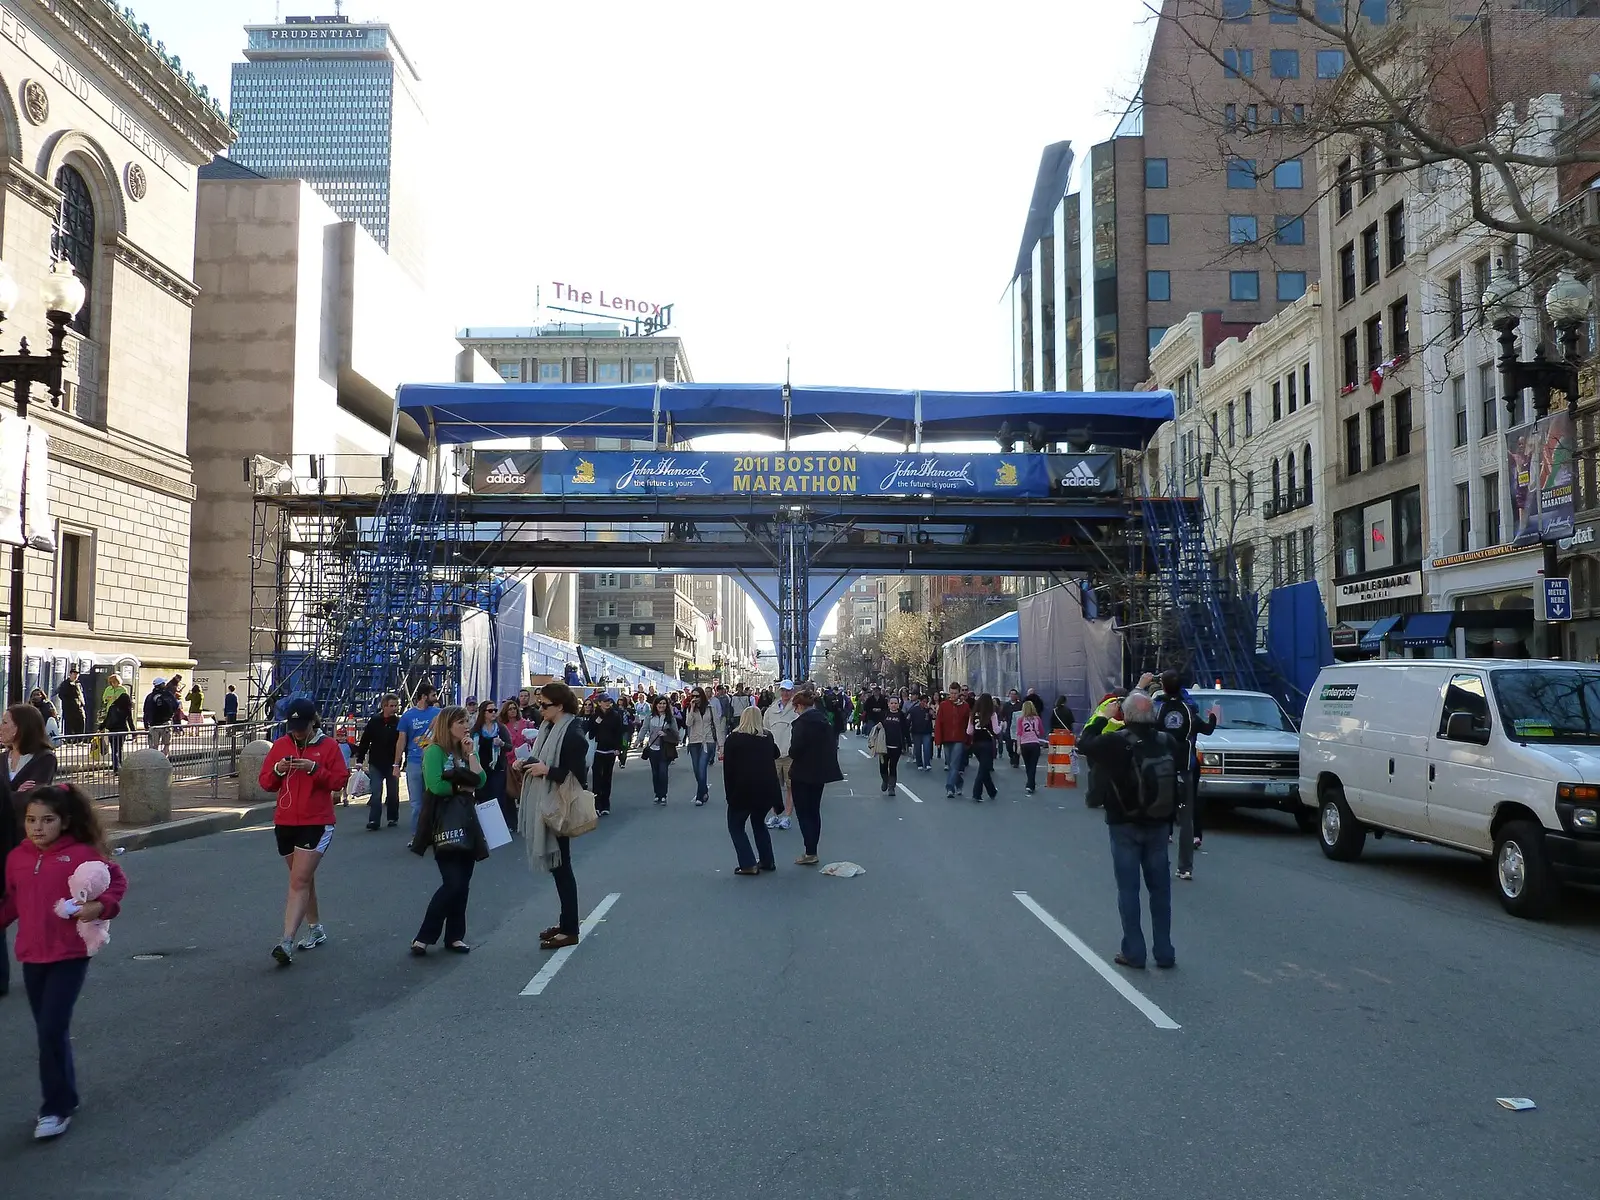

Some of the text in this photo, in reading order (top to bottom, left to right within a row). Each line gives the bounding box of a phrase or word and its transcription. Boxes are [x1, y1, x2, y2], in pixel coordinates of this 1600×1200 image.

[271, 29, 363, 39] PRUDENTIAL
[51, 60, 89, 101] AND
[110, 105, 170, 169] LIBERTY
[552, 281, 661, 317] The Lenox
[733, 456, 856, 472] 2011 BOSTON
[486, 474, 526, 484] adidas
[616, 457, 711, 490] John Hancock
[880, 458, 974, 490] John Hancock
[633, 479, 694, 489] the future is yours
[733, 475, 857, 492] MARATHON
[910, 480, 930, 488] future
[938, 482, 957, 490] yours
[1061, 476, 1101, 487] adidas
[1541, 485, 1572, 500] 2011 BOSTON
[1541, 495, 1572, 508] MARATHON
[1342, 574, 1412, 595] CHARLESMARK
[1547, 588, 1567, 596] METER
[1550, 596, 1566, 604] HERE
[1322, 687, 1356, 699] enterprise
